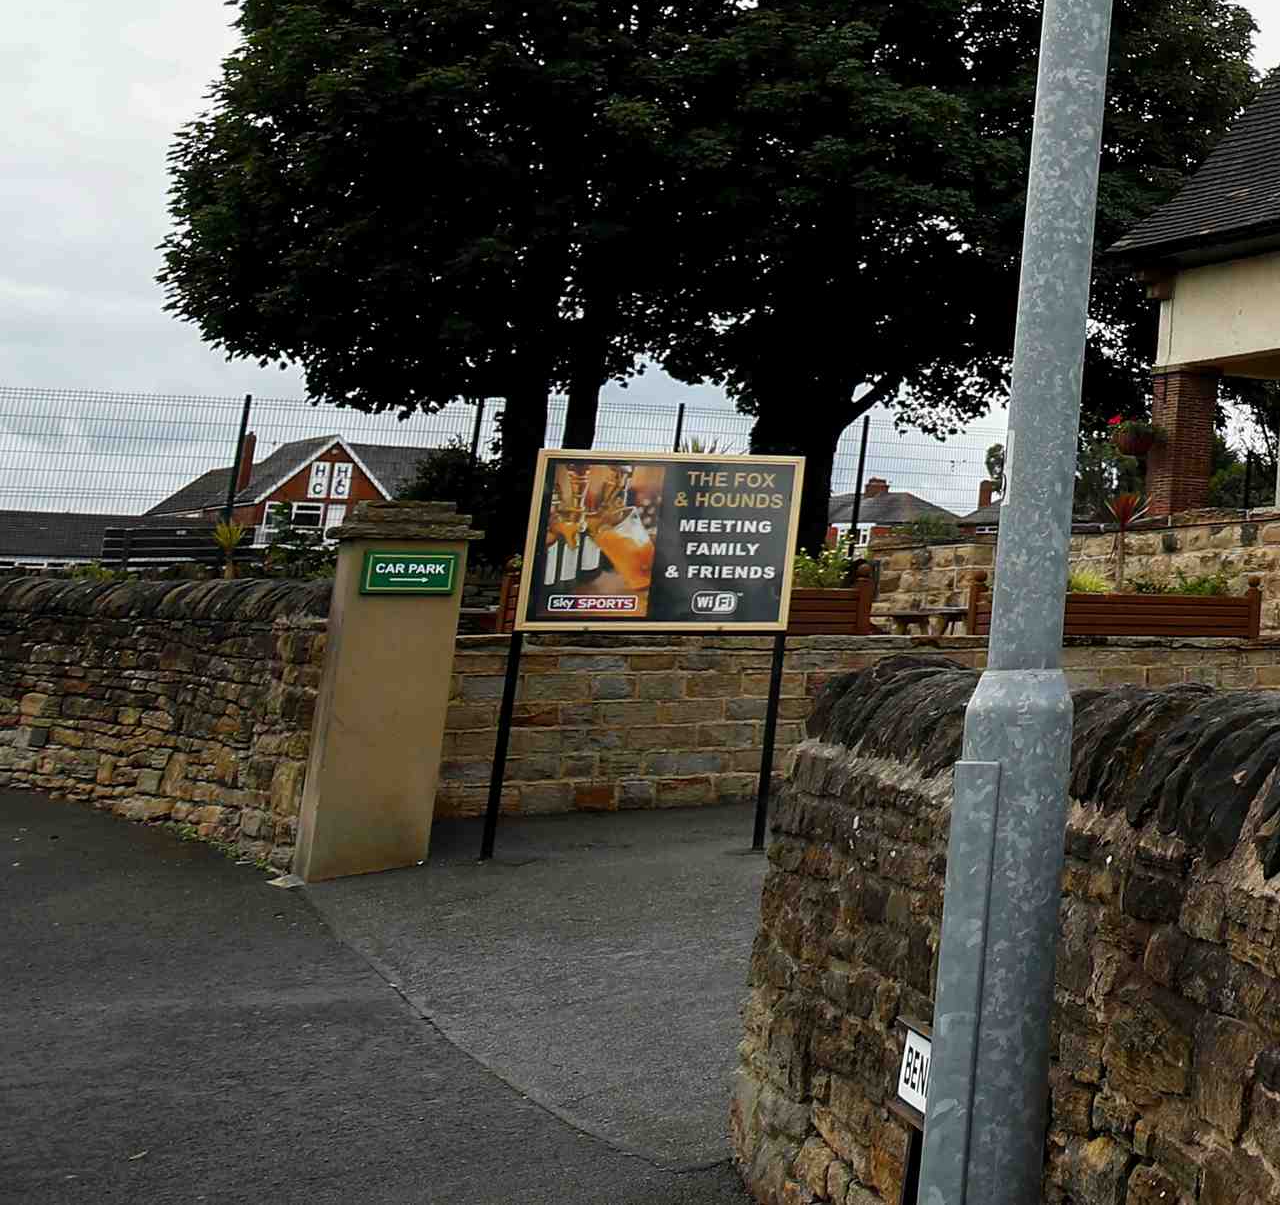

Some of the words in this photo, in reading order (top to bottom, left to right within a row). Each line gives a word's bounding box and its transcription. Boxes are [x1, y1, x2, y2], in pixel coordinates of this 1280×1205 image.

[688, 471, 728, 487] THE
[735, 472, 776, 488] FOX
[674, 491, 688, 507] &
[695, 492, 784, 508] HOUNDS
[680, 519, 772, 533] MEETING
[686, 542, 760, 556] FAMILY
[376, 563, 405, 574] CAR
[408, 564, 446, 574] PARK
[665, 565, 679, 578] &
[687, 565, 776, 579] FRIENDS
[552, 598, 574, 609] sky
[577, 598, 633, 609] SPORTS
